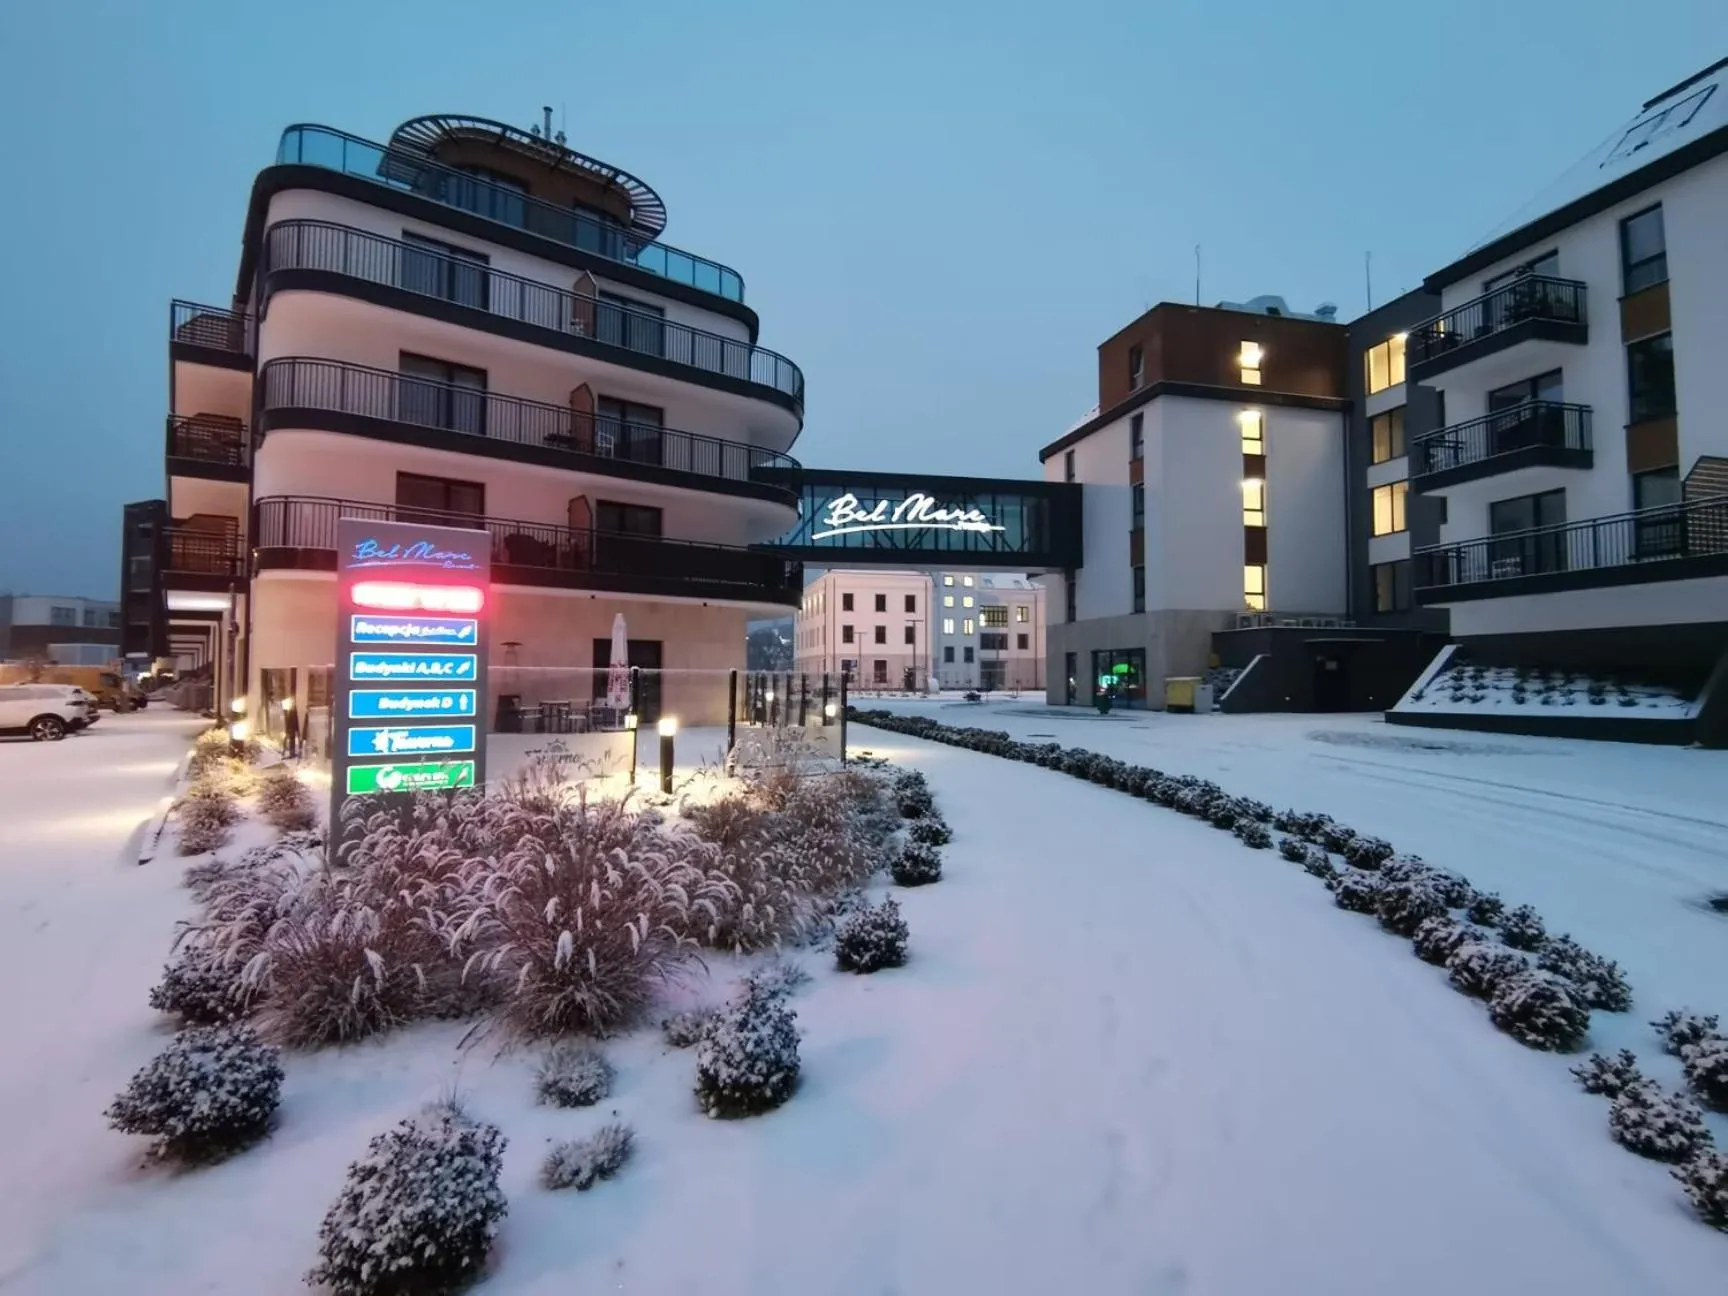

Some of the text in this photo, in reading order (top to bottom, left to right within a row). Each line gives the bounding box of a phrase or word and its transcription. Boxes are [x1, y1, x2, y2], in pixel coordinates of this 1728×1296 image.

[823, 493, 986, 526] Bel Mare
[351, 538, 474, 561] Bel Mare
